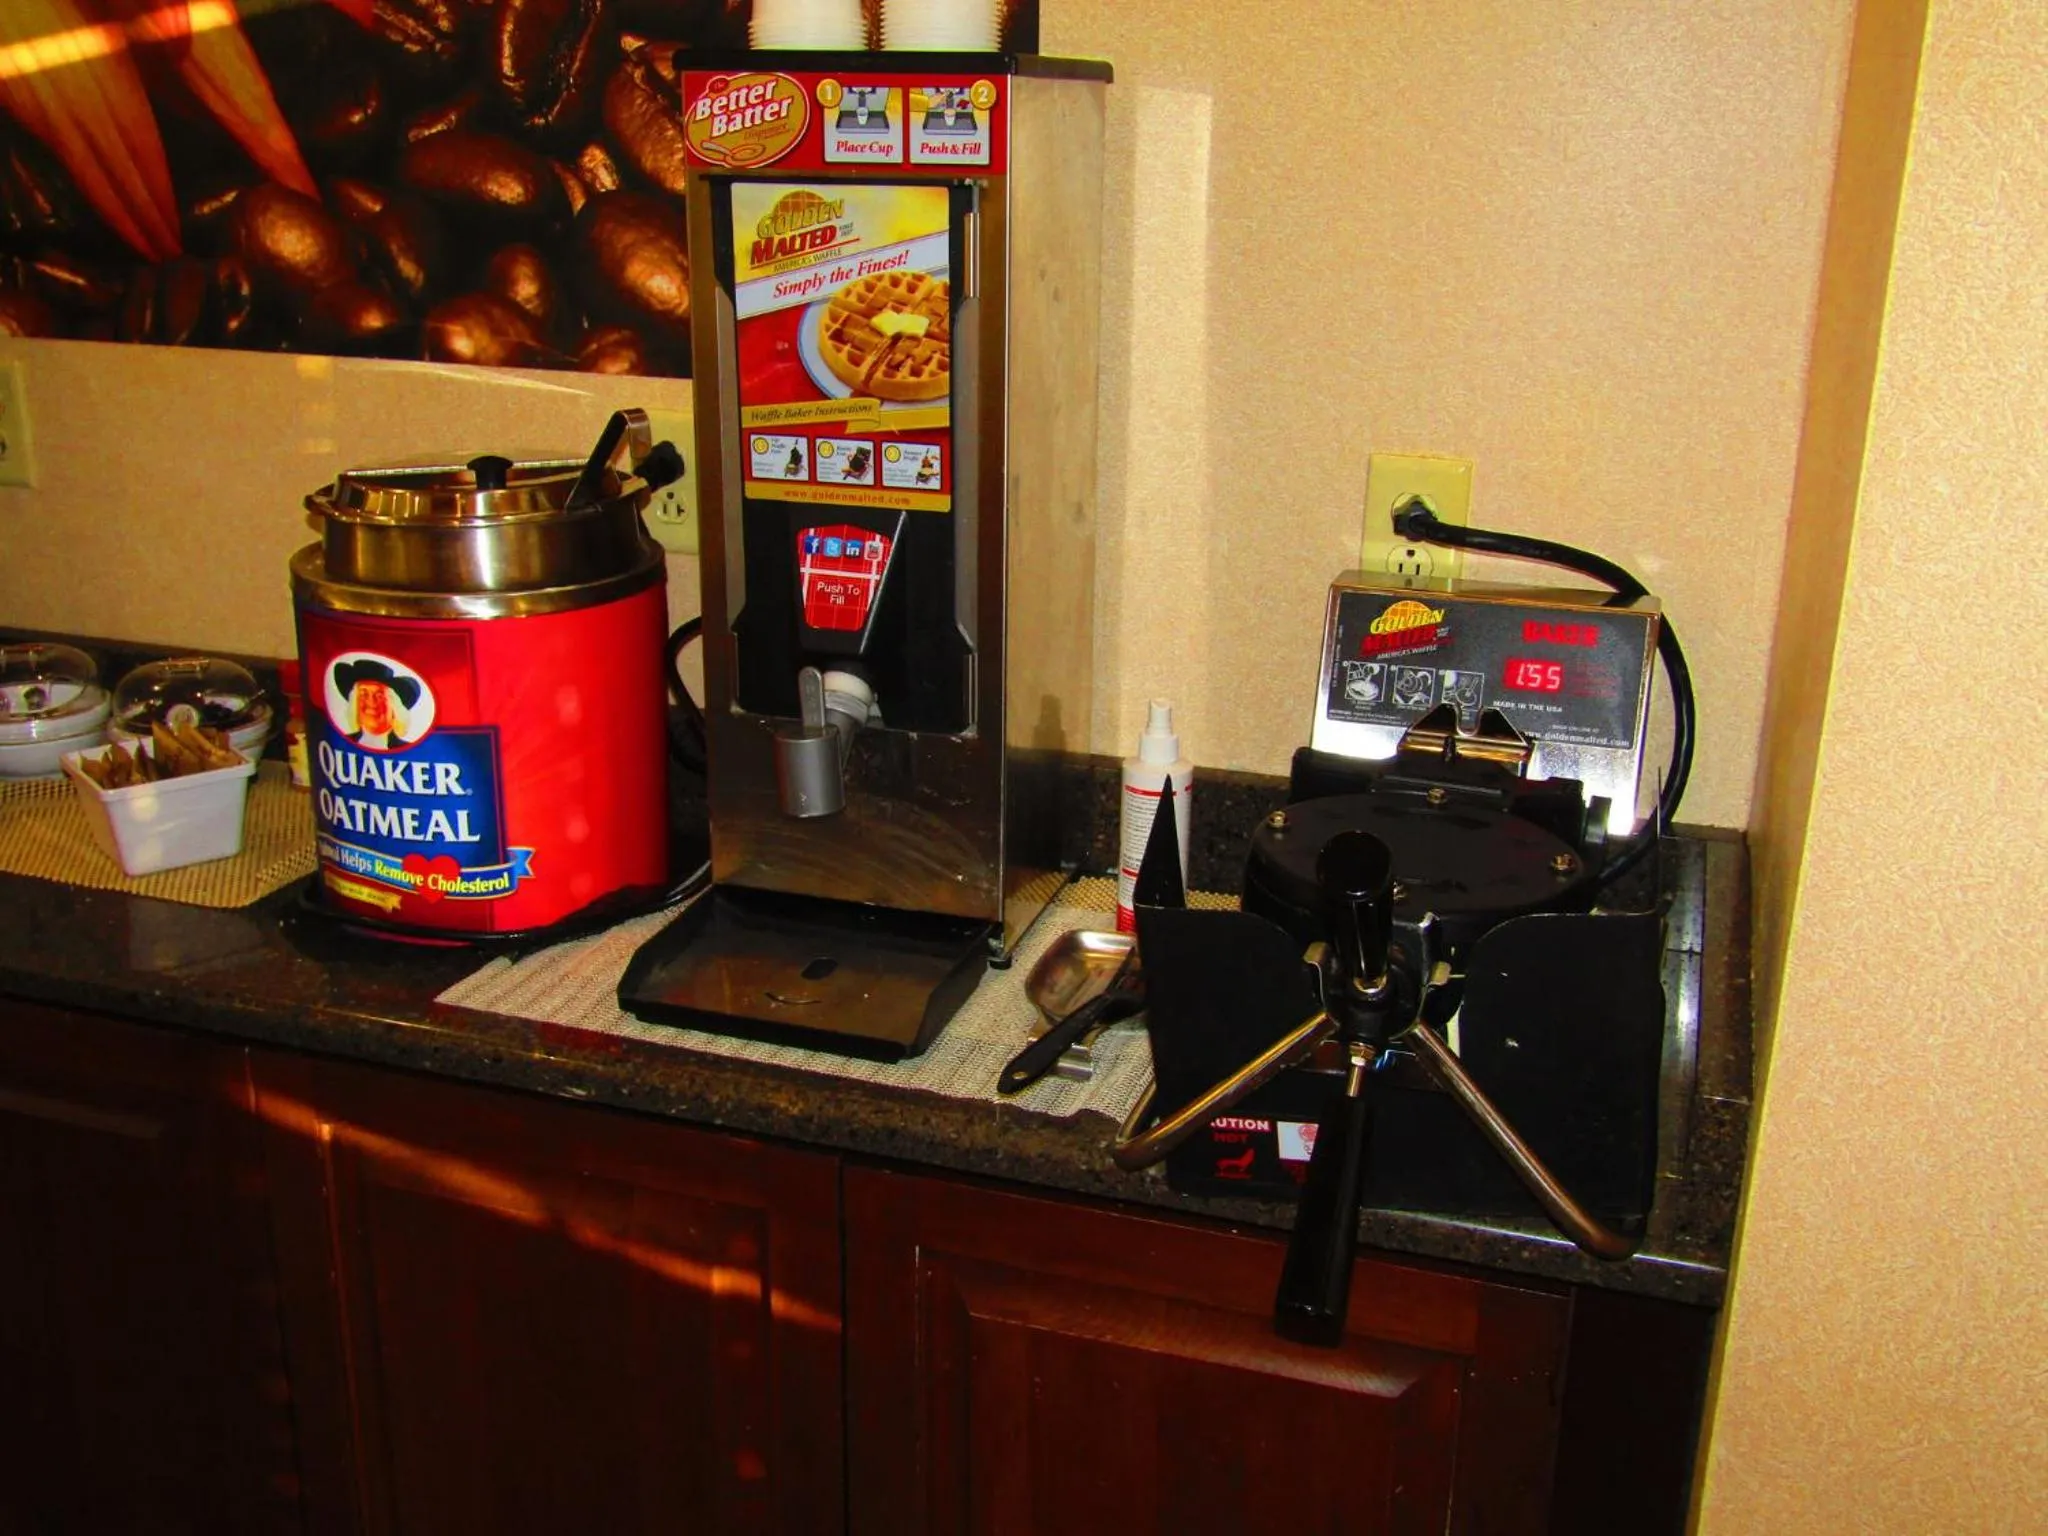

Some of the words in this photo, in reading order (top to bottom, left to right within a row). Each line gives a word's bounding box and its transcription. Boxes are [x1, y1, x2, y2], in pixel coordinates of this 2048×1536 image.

[695, 80, 778, 121] Better
[824, 85, 834, 101] 1
[978, 86, 989, 102] 2
[711, 98, 793, 138] Batter
[836, 140, 867, 153] Place
[868, 141, 894, 157] Cup
[920, 142, 949, 155] Push
[950, 144, 960, 155] &
[961, 142, 982, 155] Fill
[757, 199, 845, 240] GOLDEN
[751, 225, 837, 265] MALTED
[773, 274, 826, 299] Simply
[829, 267, 854, 284] the
[858, 249, 911, 276] Finest!
[751, 408, 783, 421] Waffle
[784, 407, 812, 419] Baker
[816, 581, 844, 594] Push
[847, 584, 861, 596] To
[829, 594, 845, 605] Fill
[1529, 703, 1544, 711] THE
[1546, 705, 1563, 713] USA
[317, 740, 467, 797] QUAKER
[319, 787, 482, 843] OATMEAL
[340, 848, 373, 873] Helps
[374, 858, 424, 886] Remove
[427, 872, 511, 894] Cholesterol
[1210, 1116, 1270, 1131] UTION
